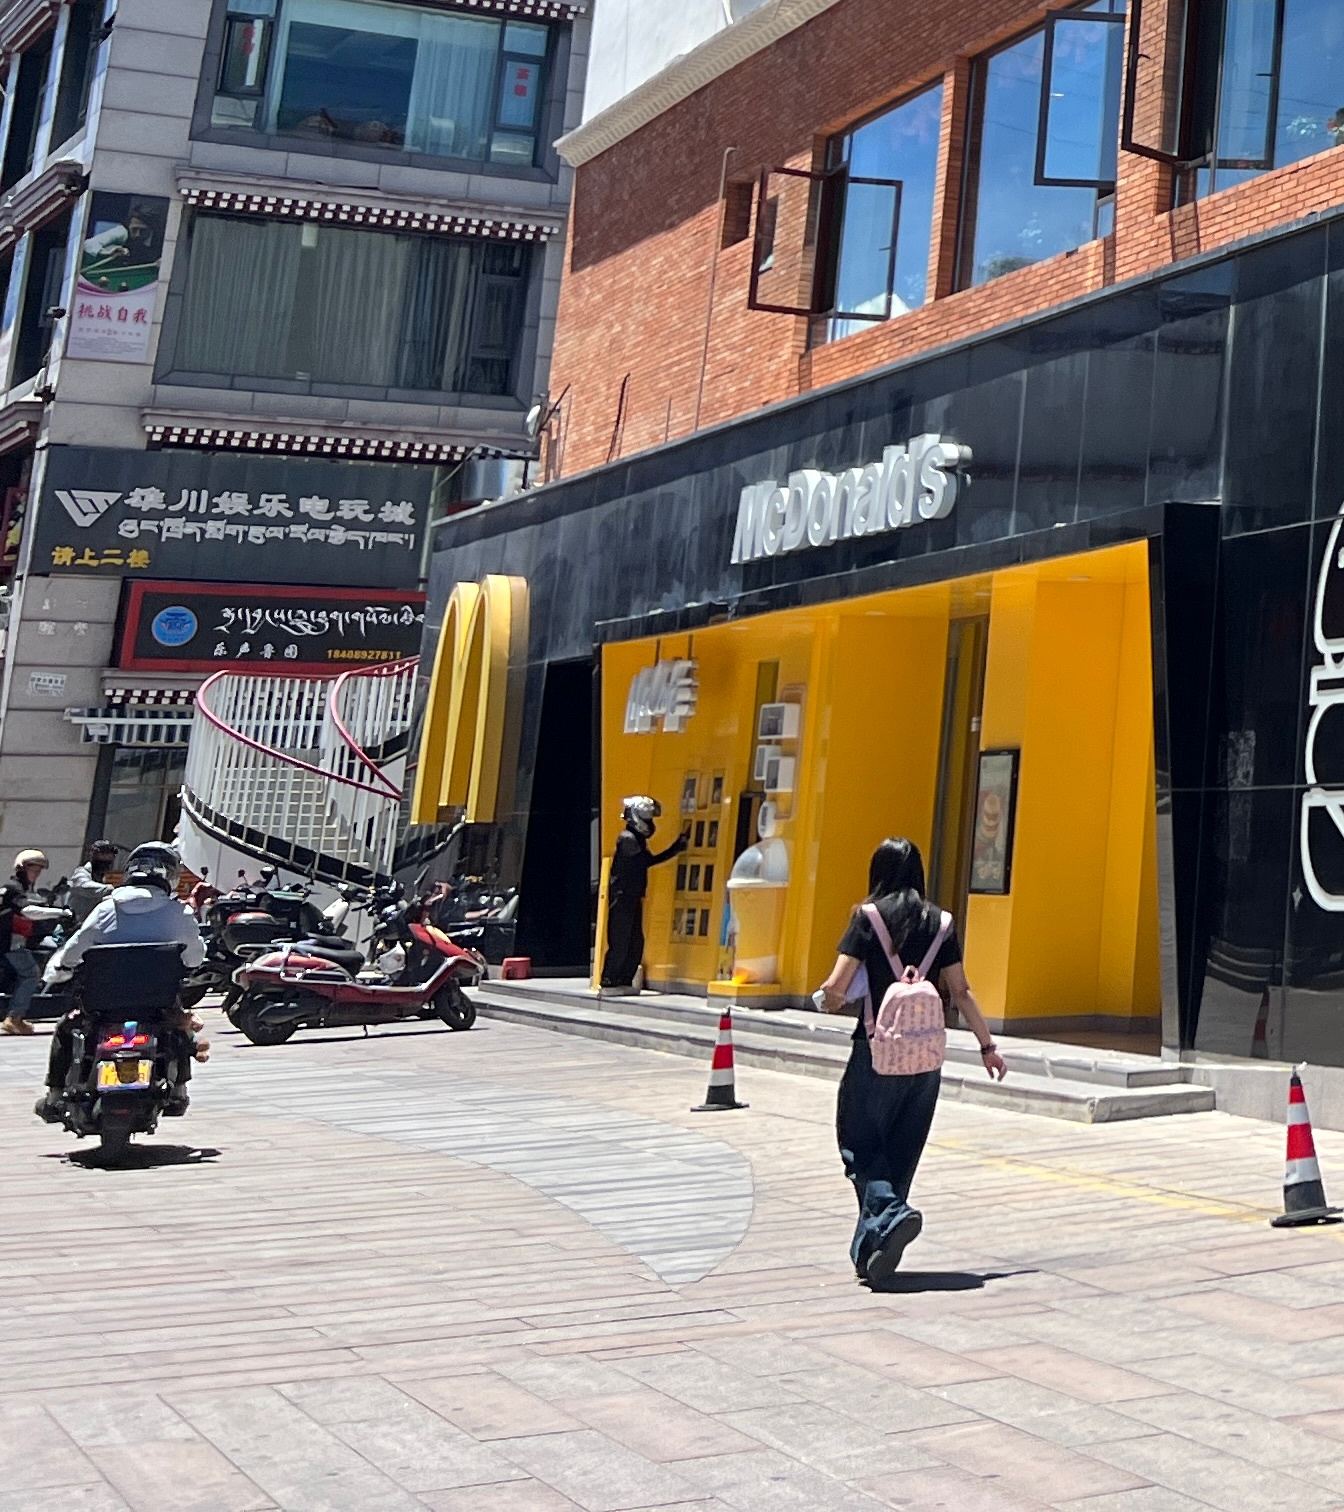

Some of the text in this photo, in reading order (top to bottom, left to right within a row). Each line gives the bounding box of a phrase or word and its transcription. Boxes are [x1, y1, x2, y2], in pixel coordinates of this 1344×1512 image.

[77, 303, 148, 324] 挑战自我
[124, 486, 416, 525] 雄川娱乐电玩城
[52, 546, 150, 569] 请上二楼
